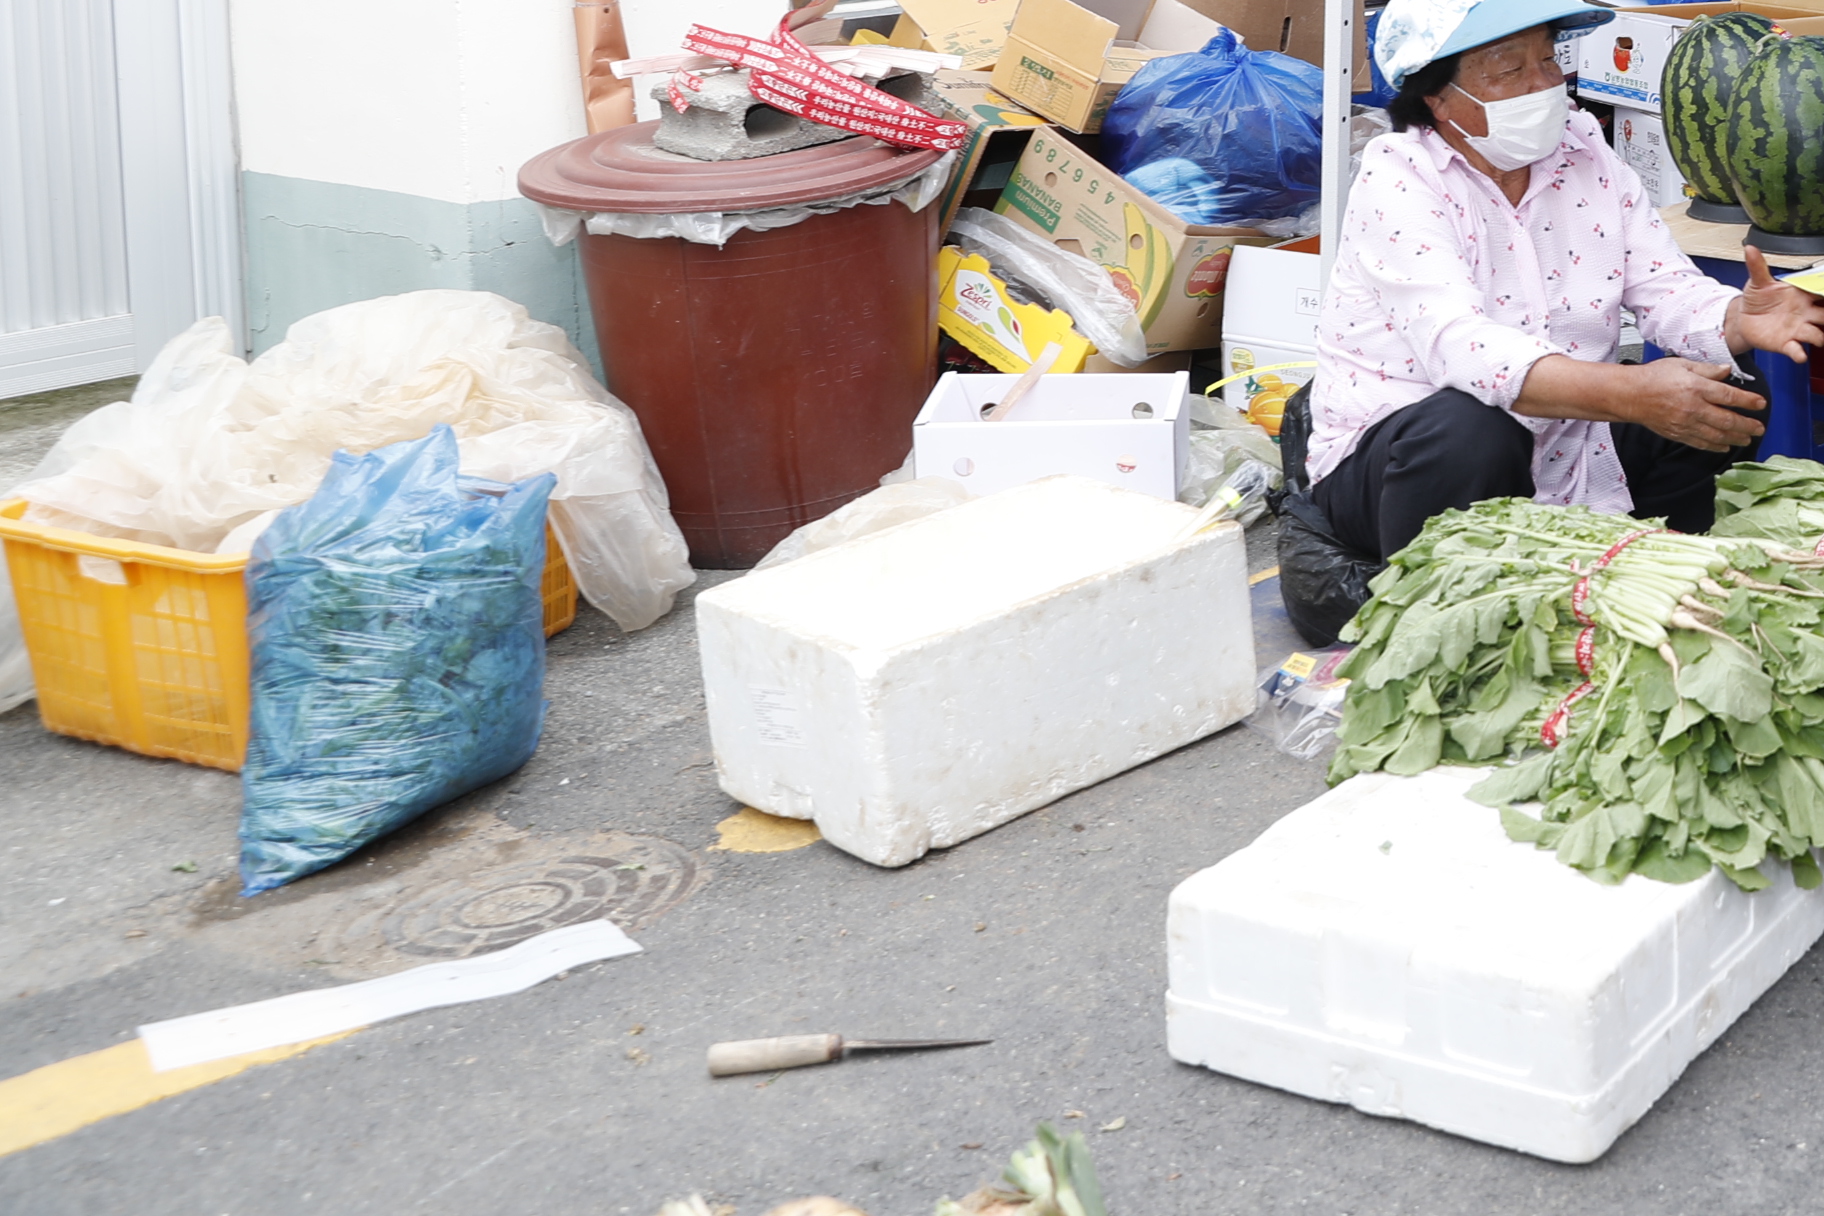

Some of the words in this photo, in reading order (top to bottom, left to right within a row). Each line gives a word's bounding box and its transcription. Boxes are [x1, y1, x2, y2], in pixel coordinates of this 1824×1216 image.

[1033, 139, 1044, 154] 9
[1046, 148, 1057, 163] 8
[1058, 159, 1071, 174] 7
[1072, 168, 1084, 182] 6
[1016, 172, 1063, 213] BANANAS
[1087, 179, 1099, 194] 5
[1104, 191, 1115, 205] 4
[1015, 190, 1055, 226] Premium
[960, 282, 993, 311] Zespri
[1300, 296, 1319, 311] 개수
